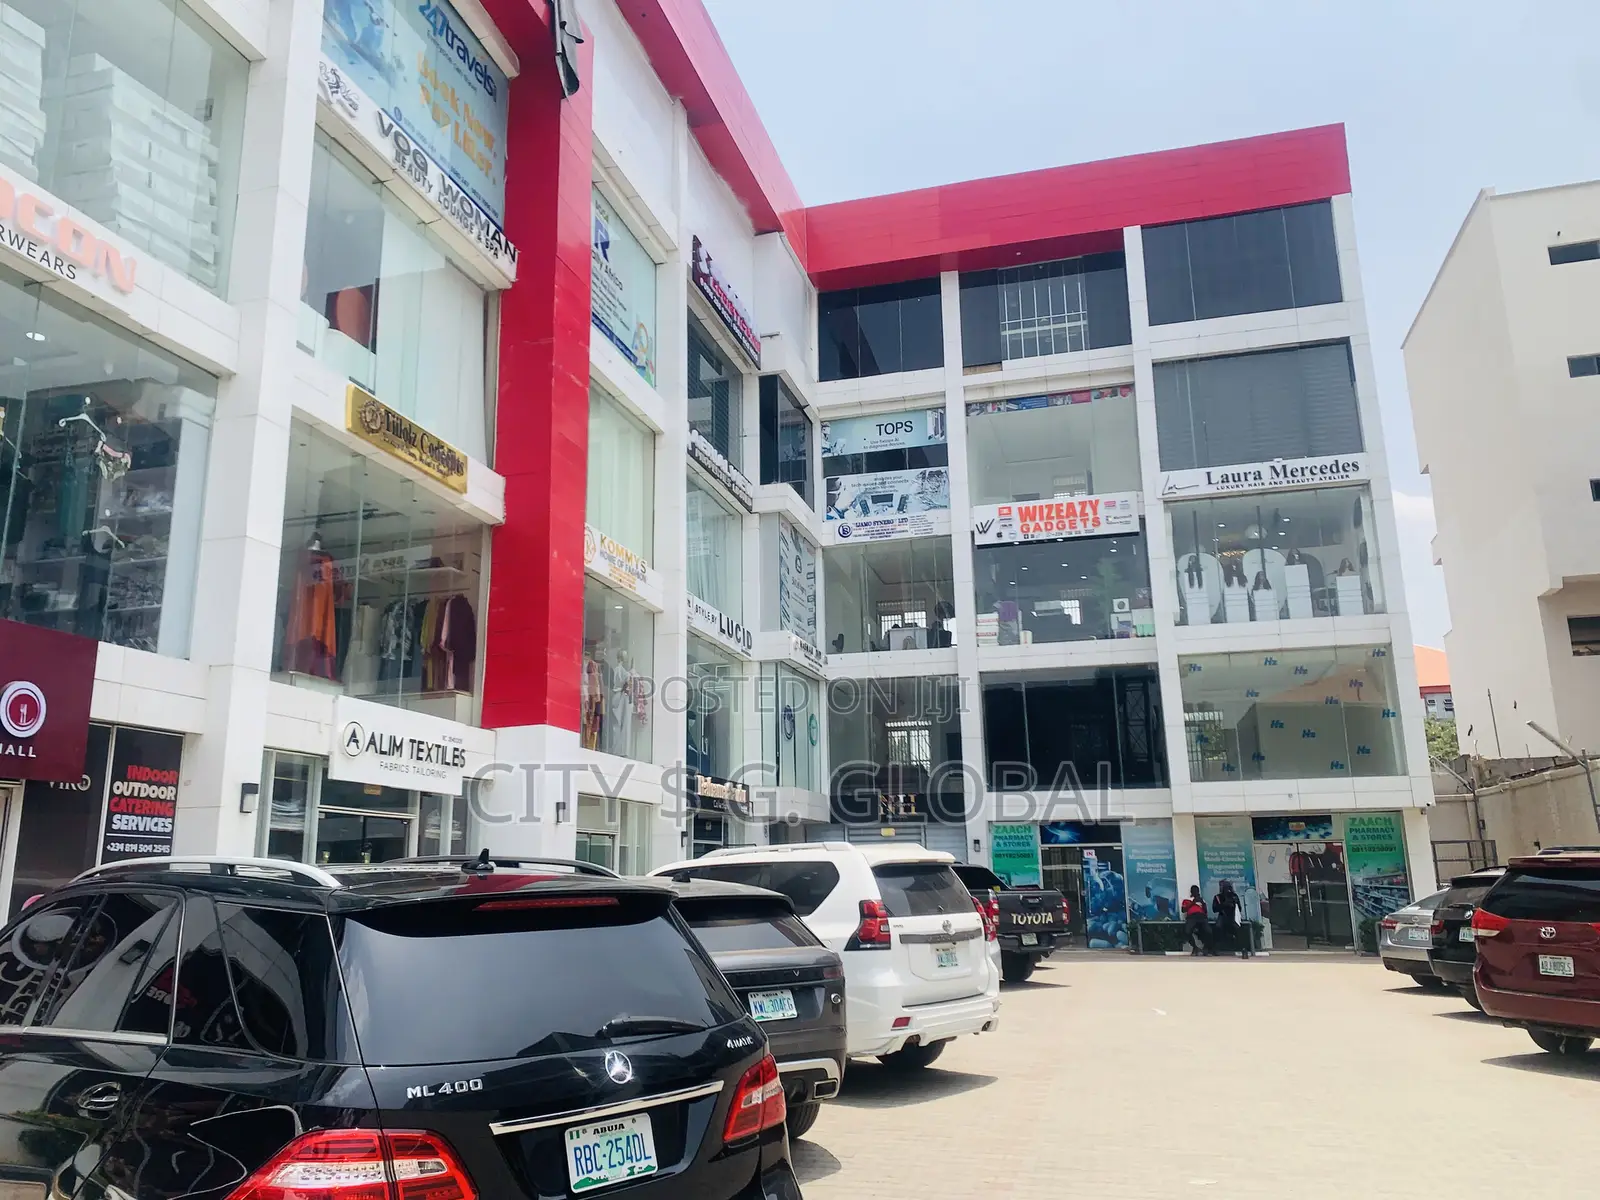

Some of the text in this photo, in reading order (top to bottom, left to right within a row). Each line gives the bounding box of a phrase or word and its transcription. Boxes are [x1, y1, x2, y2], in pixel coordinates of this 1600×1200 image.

[395, 149, 433, 193] BEAUTY
[438, 191, 474, 235] LOUNGE
[485, 238, 499, 260] SPA
[440, 173, 517, 263] WOMAN
[0, 176, 137, 294] CON
[876, 421, 913, 436] TOPS
[1205, 460, 1360, 485] Laura Mercedes
[1018, 499, 1100, 523] WIZEAZY
[1020, 516, 1101, 534] GADGETS
[600, 534, 646, 574] KOMMYS
[695, 604, 710, 621] STYLE
[719, 612, 752, 650] LUCID
[0, 745, 37, 758] ALL
[365, 731, 466, 768] ALIM TEXTILES
[127, 765, 178, 784] INDOOR
[380, 761, 447, 779] FABRICS TAILORING
[112, 781, 177, 800] OUTDOOR
[110, 796, 174, 817] CATERING
[112, 814, 173, 833] SERVICES
[994, 825, 1032, 834] ZAACH
[1349, 816, 1393, 826] ZAACH
[1011, 912, 1054, 925] TOYOTA
[407, 1079, 483, 1099] ML 400
[593, 1123, 625, 1135] ABUJA
